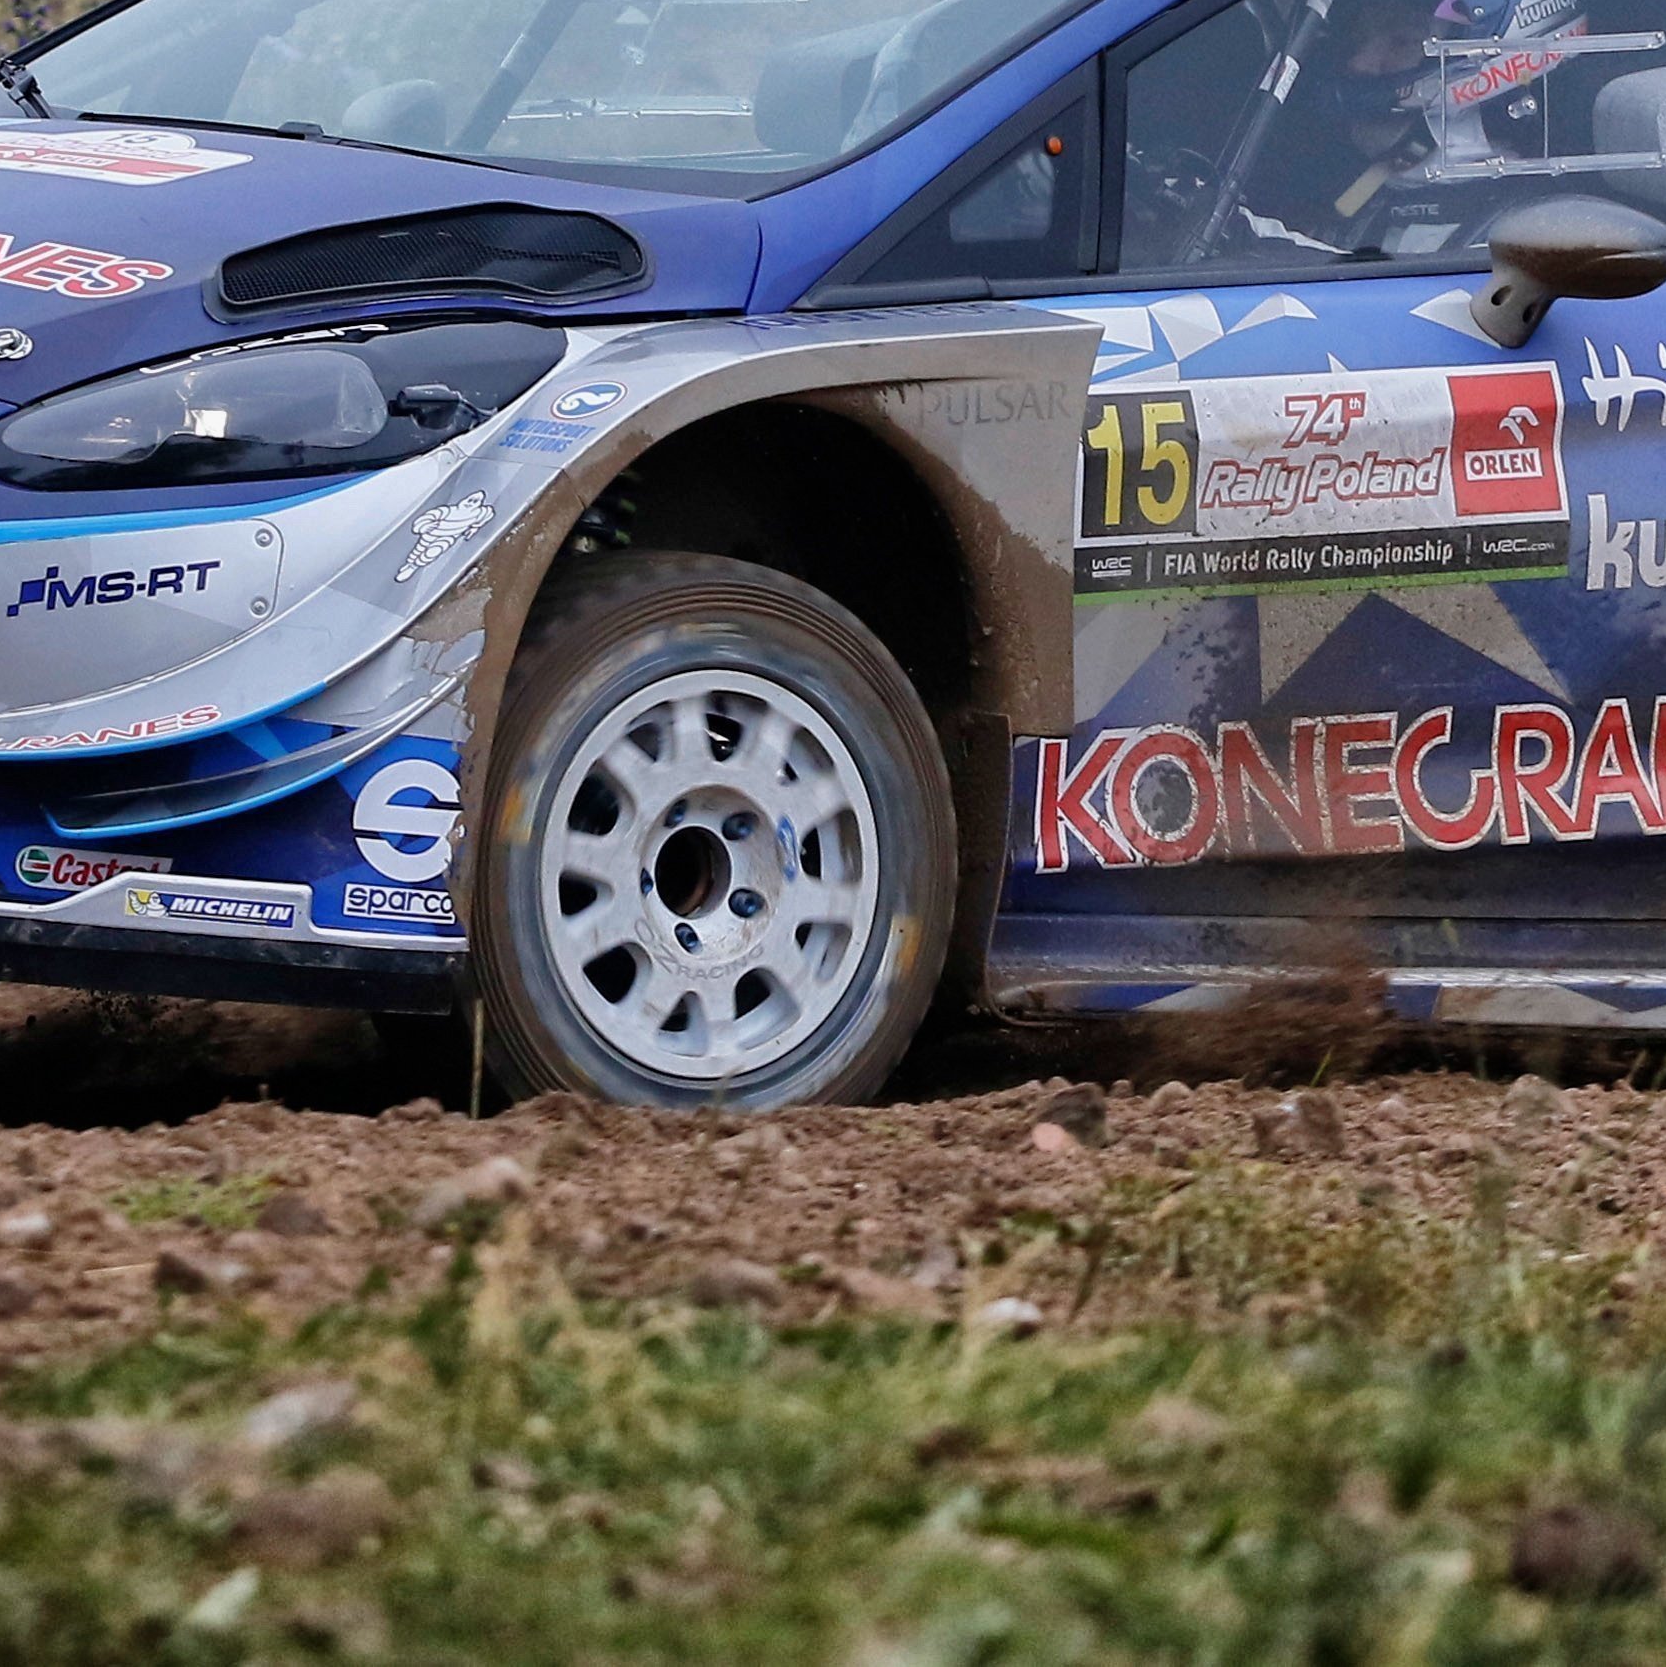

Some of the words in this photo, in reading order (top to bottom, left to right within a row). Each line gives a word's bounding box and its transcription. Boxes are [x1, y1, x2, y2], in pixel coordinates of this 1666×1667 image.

[919, 382, 1071, 427] PULSAR
[1087, 401, 1191, 526] 15
[1199, 457, 1305, 517] Rally
[1302, 446, 1449, 503] Poland
[1469, 452, 1537, 476] ORLEN
[1163, 552, 1197, 576] FIA
[1202, 549, 1260, 575] World
[1266, 547, 1316, 574] Rally
[1320, 540, 1454, 570] Championship
[45, 561, 221, 611] MS-RT
[52, 853, 161, 886] Cast
[169, 896, 292, 923] MICHELIN
